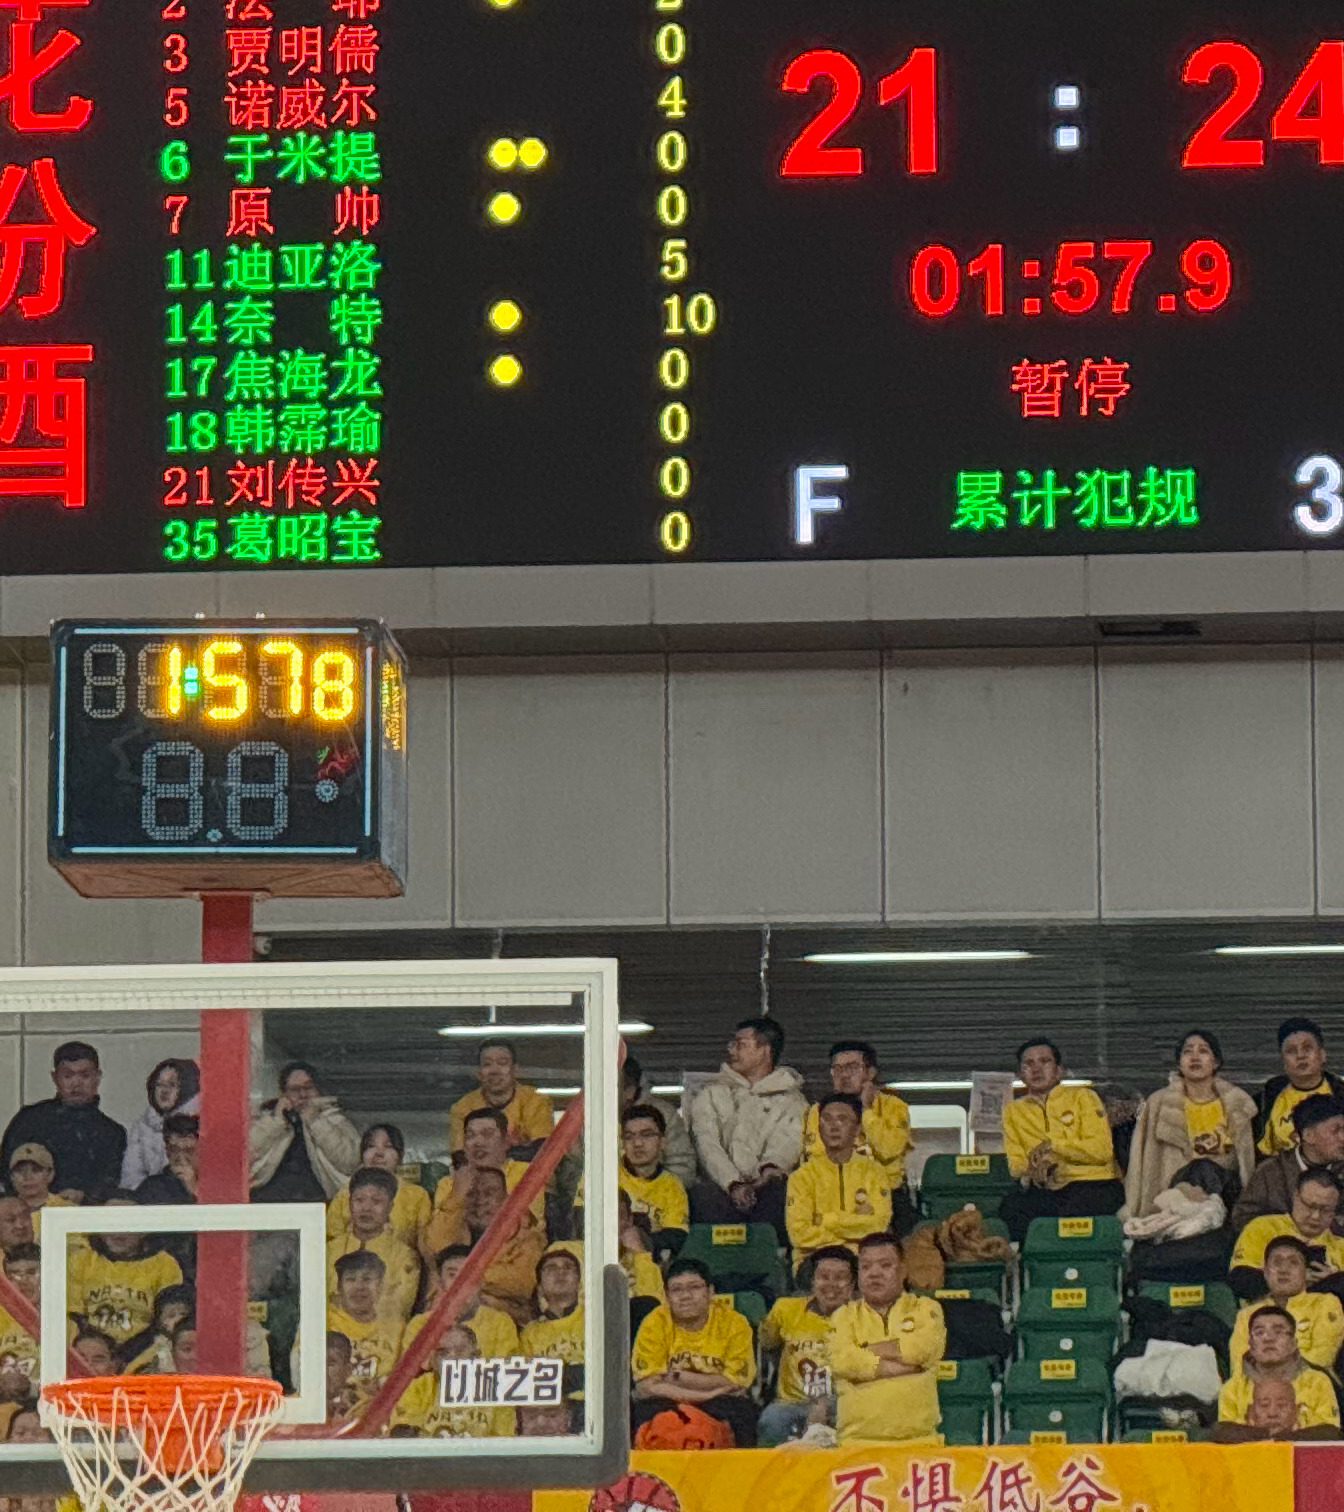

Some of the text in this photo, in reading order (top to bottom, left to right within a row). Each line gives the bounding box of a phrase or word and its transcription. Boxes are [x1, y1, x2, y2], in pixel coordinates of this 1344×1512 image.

[163, 24, 687, 76] 3 贾明儒 0
[163, 76, 688, 130] 5 诺威尔 4
[782, 48, 939, 179] 21
[160, 130, 688, 183] 6 于米提 0
[164, 195, 190, 235] 7
[659, 186, 688, 227] 0
[165, 240, 689, 291] 11 迪亚洛 5
[912, 240, 1233, 319] 01:57.9
[165, 300, 218, 344] 14
[664, 294, 717, 336] 10
[165, 347, 690, 401] 17 焦海龙 0
[1012, 357, 1131, 419] 暂停
[166, 411, 218, 453] 18
[661, 403, 690, 445] 0
[162, 458, 691, 508] 21 刘传兴 0
[796, 465, 850, 546] F
[952, 467, 1200, 531] 累计犯规
[163, 520, 218, 561] 35
[661, 512, 691, 554] 0
[445, 1360, 559, 1403] 以城之名
